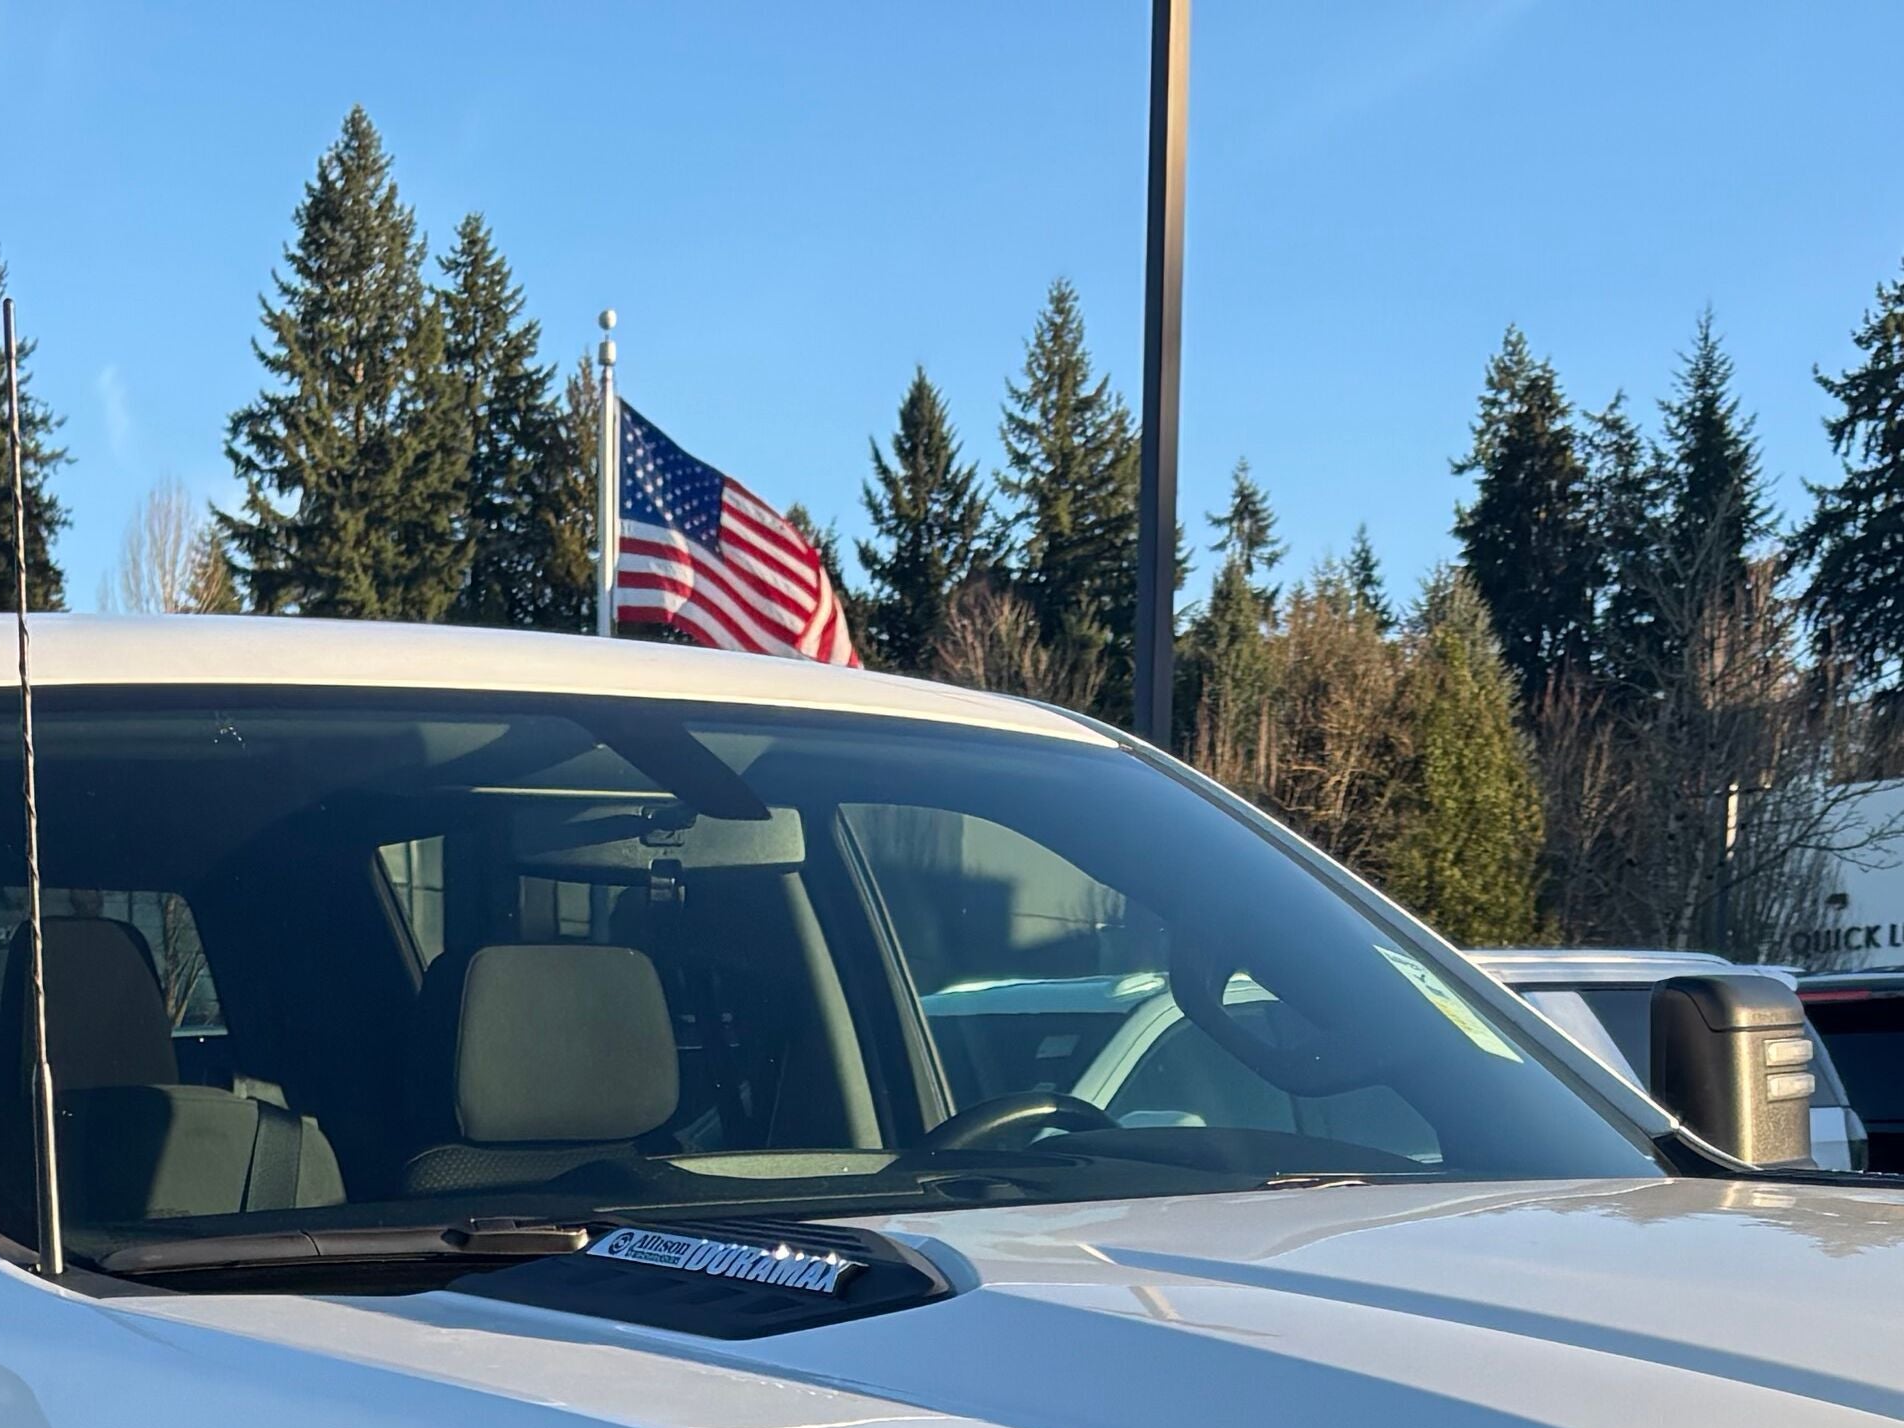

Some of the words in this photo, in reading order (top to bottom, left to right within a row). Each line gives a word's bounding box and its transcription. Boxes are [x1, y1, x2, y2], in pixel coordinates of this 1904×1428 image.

[1790, 924, 1881, 957] QUICK
[633, 1234, 691, 1256] Allison
[684, 1240, 841, 1293] DURAMAX
